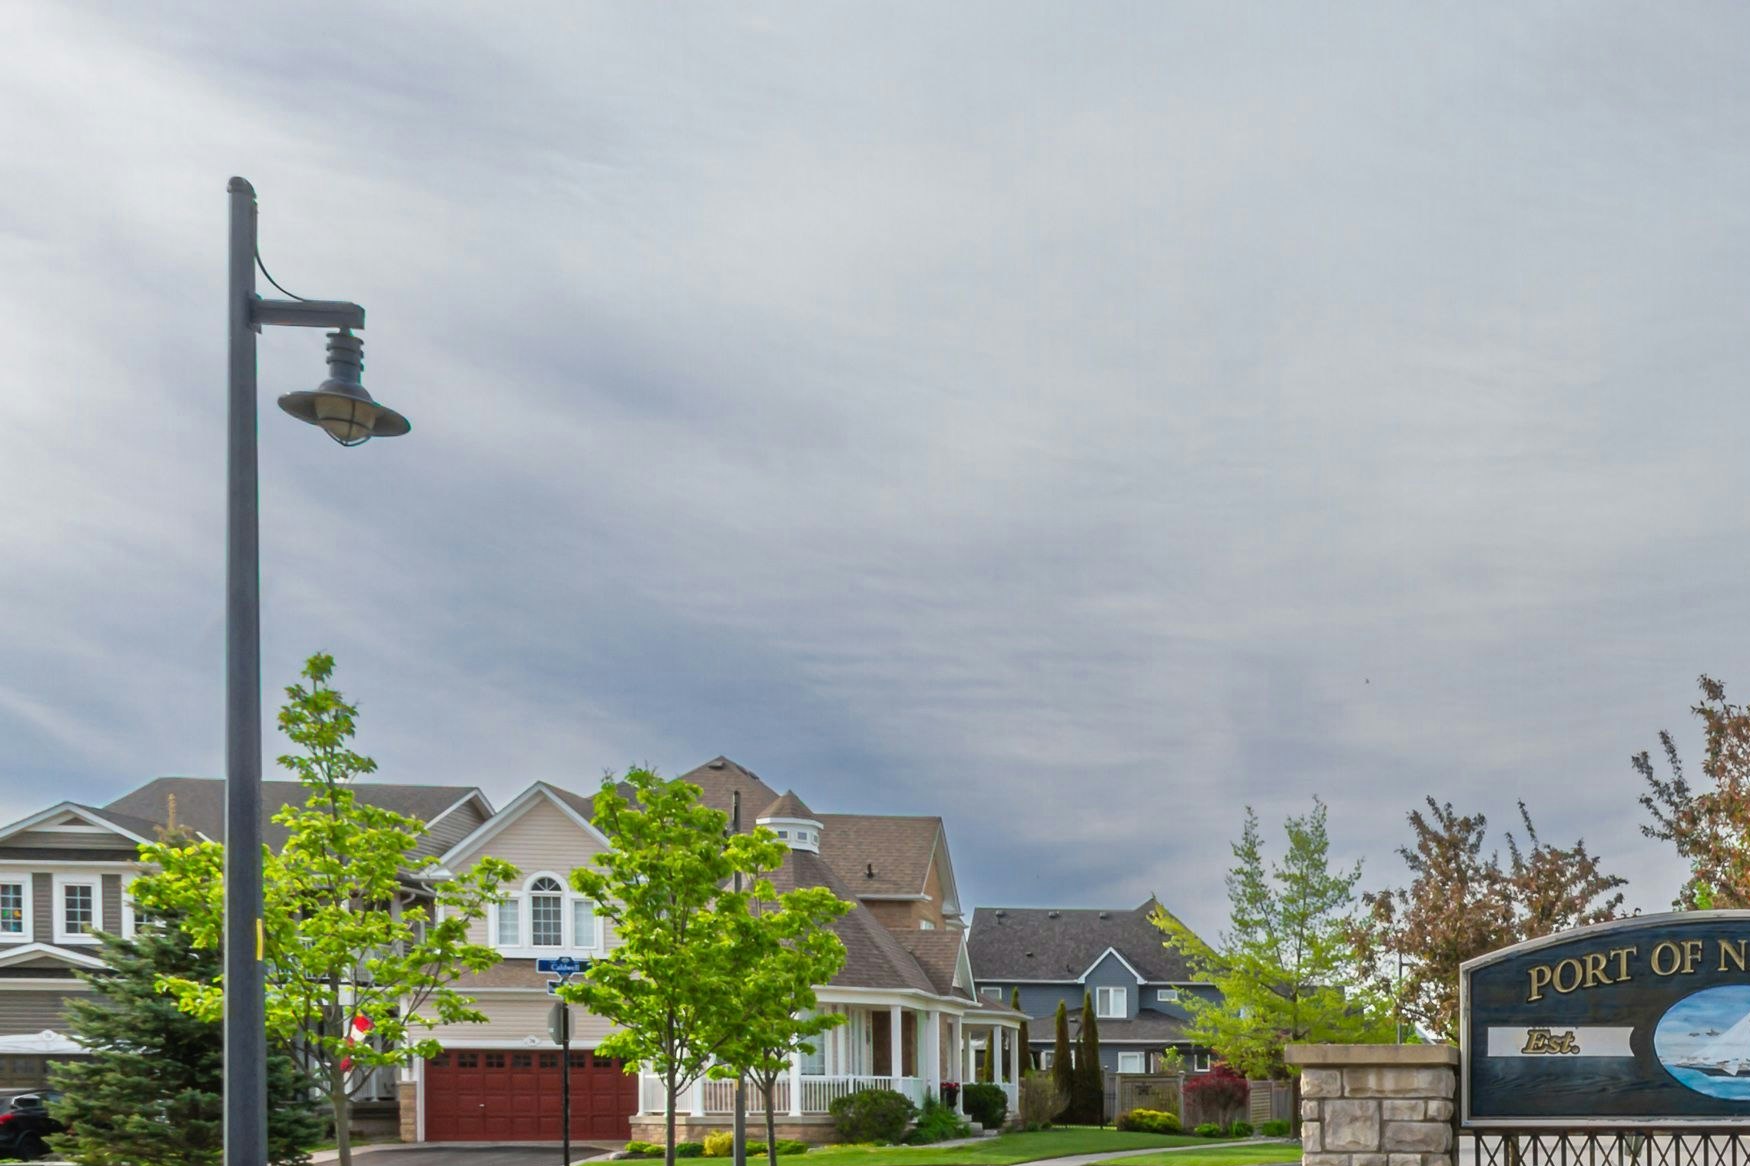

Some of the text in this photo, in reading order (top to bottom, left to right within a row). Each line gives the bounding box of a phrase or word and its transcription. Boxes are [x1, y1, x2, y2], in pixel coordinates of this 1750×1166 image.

[1527, 945, 1638, 1002] PORT
[1650, 939, 1704, 977] OF
[1521, 1029, 1580, 1054] Est.
